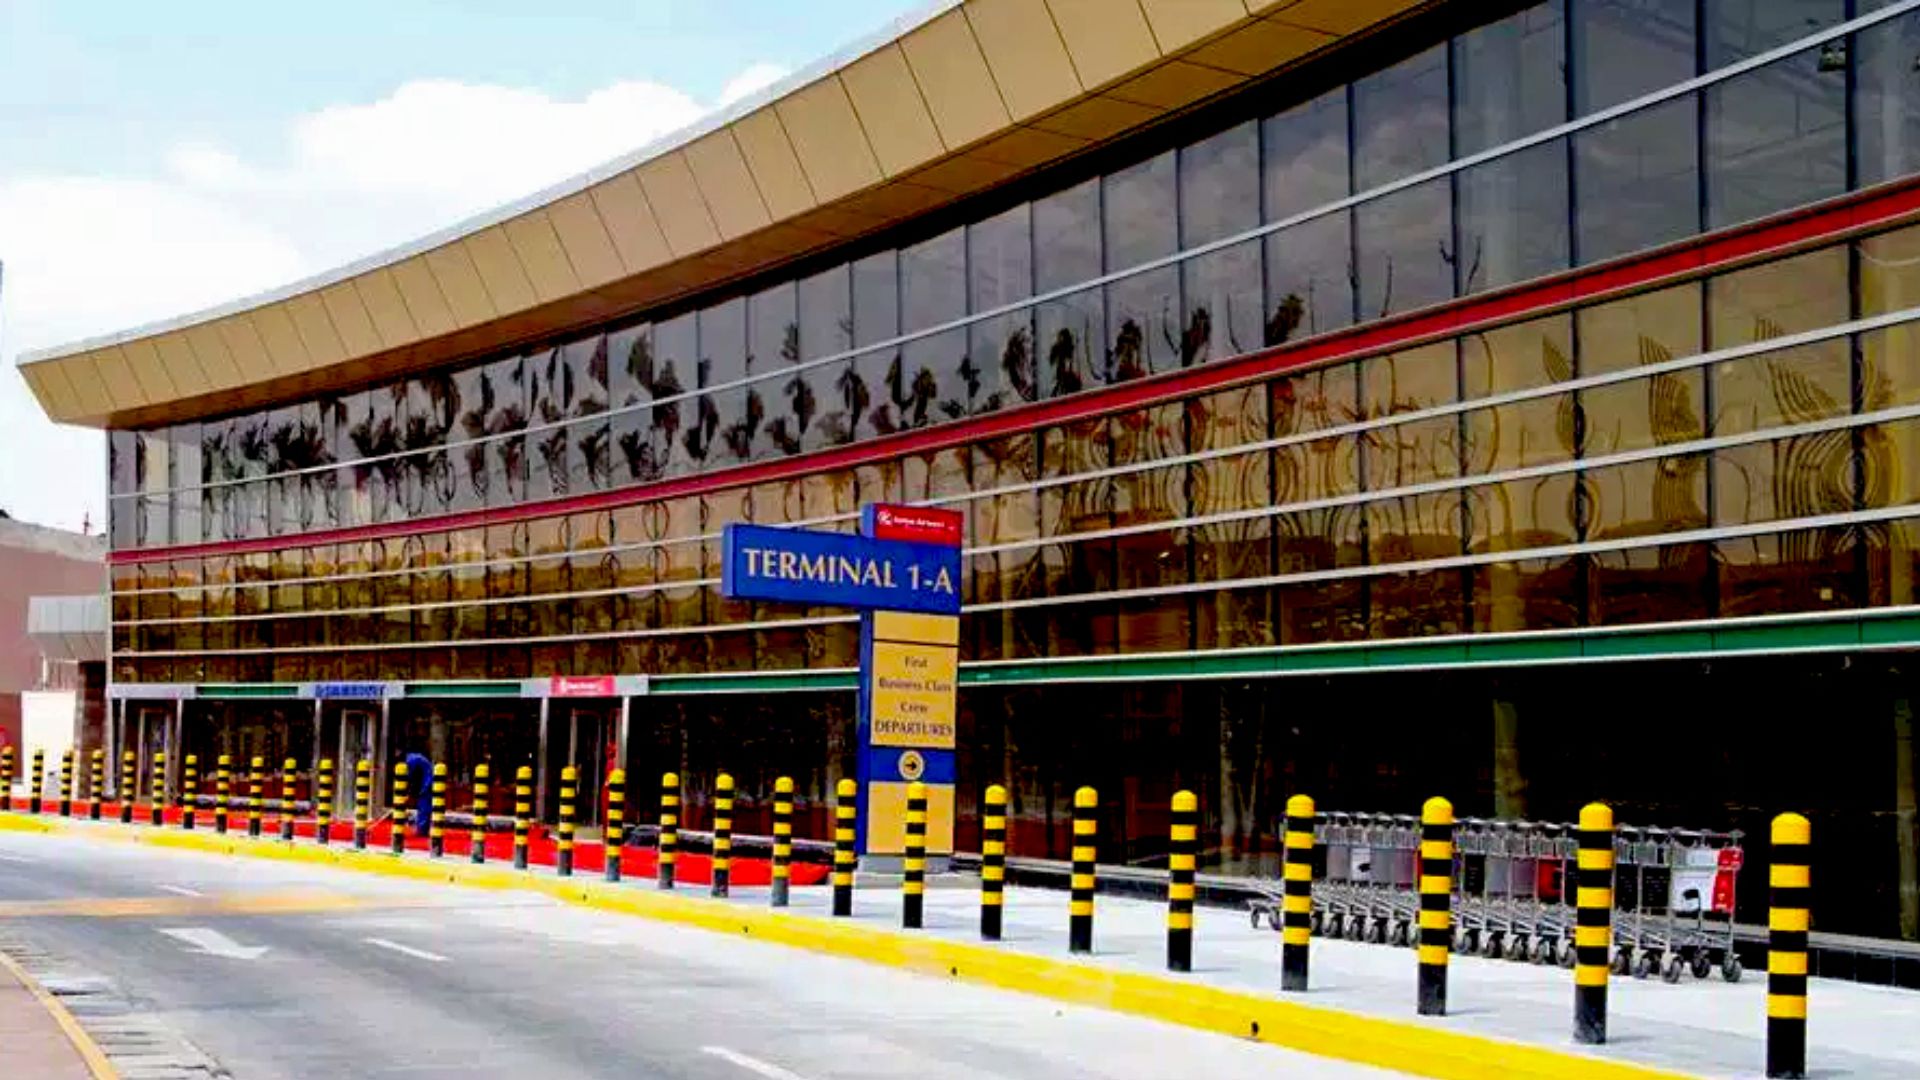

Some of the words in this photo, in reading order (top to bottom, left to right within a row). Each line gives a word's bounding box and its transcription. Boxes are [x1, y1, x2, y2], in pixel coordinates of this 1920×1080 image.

[743, 547, 897, 589] TERMINAL
[907, 564, 953, 594] 1-A
[875, 720, 953, 736] DEPARTURES
